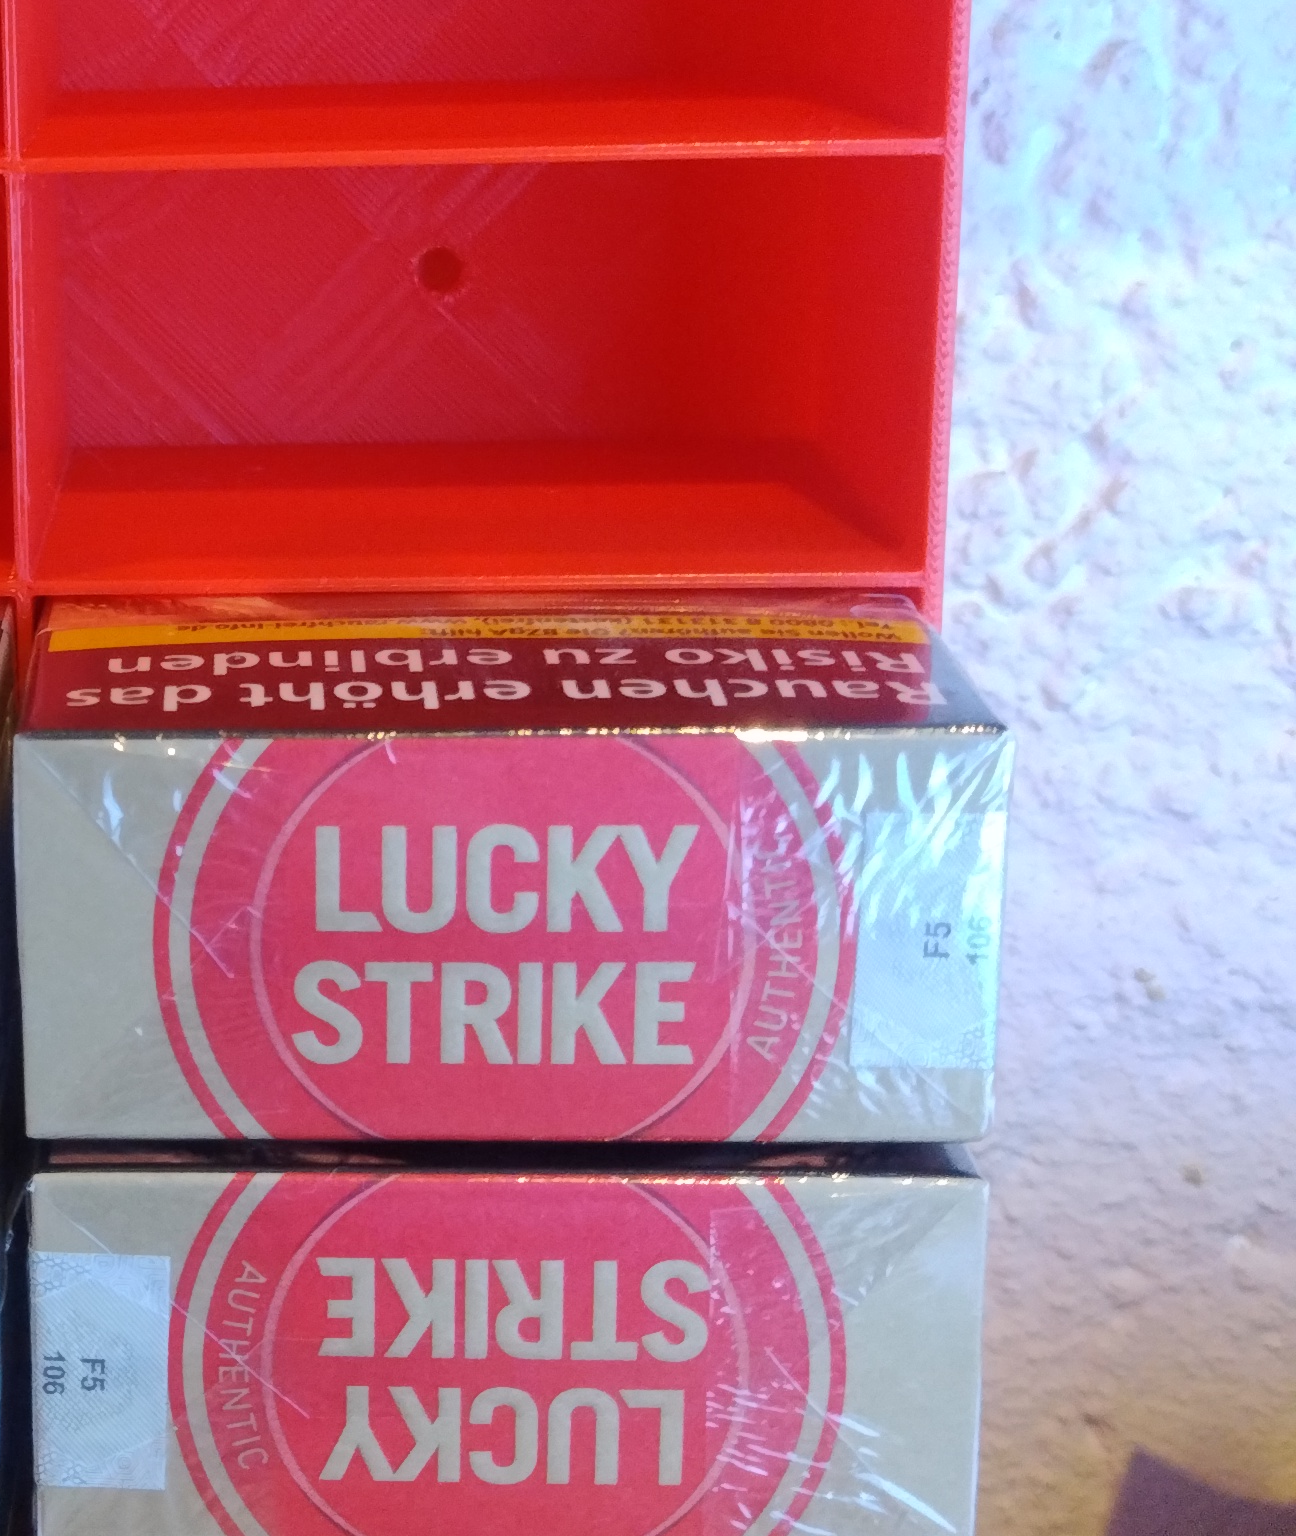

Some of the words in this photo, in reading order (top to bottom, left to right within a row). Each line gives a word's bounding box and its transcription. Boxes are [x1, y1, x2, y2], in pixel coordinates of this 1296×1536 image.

[108, 648, 513, 676] erblinden
[543, 648, 636, 665] zu
[664, 648, 925, 674] Risiko
[65, 685, 212, 712] das
[240, 681, 532, 711] erhöht
[562, 678, 948, 707] Rauchen
[313, 824, 699, 935] LUCKY
[923, 921, 952, 962] F5
[292, 962, 696, 1064] STRIKE
[316, 1255, 710, 1362] STRIKE
[42, 1351, 66, 1395] 106
[80, 1358, 106, 1392] F5
[217, 1260, 269, 1470] AUTHENTIC
[318, 1384, 686, 1487] LUCKY
